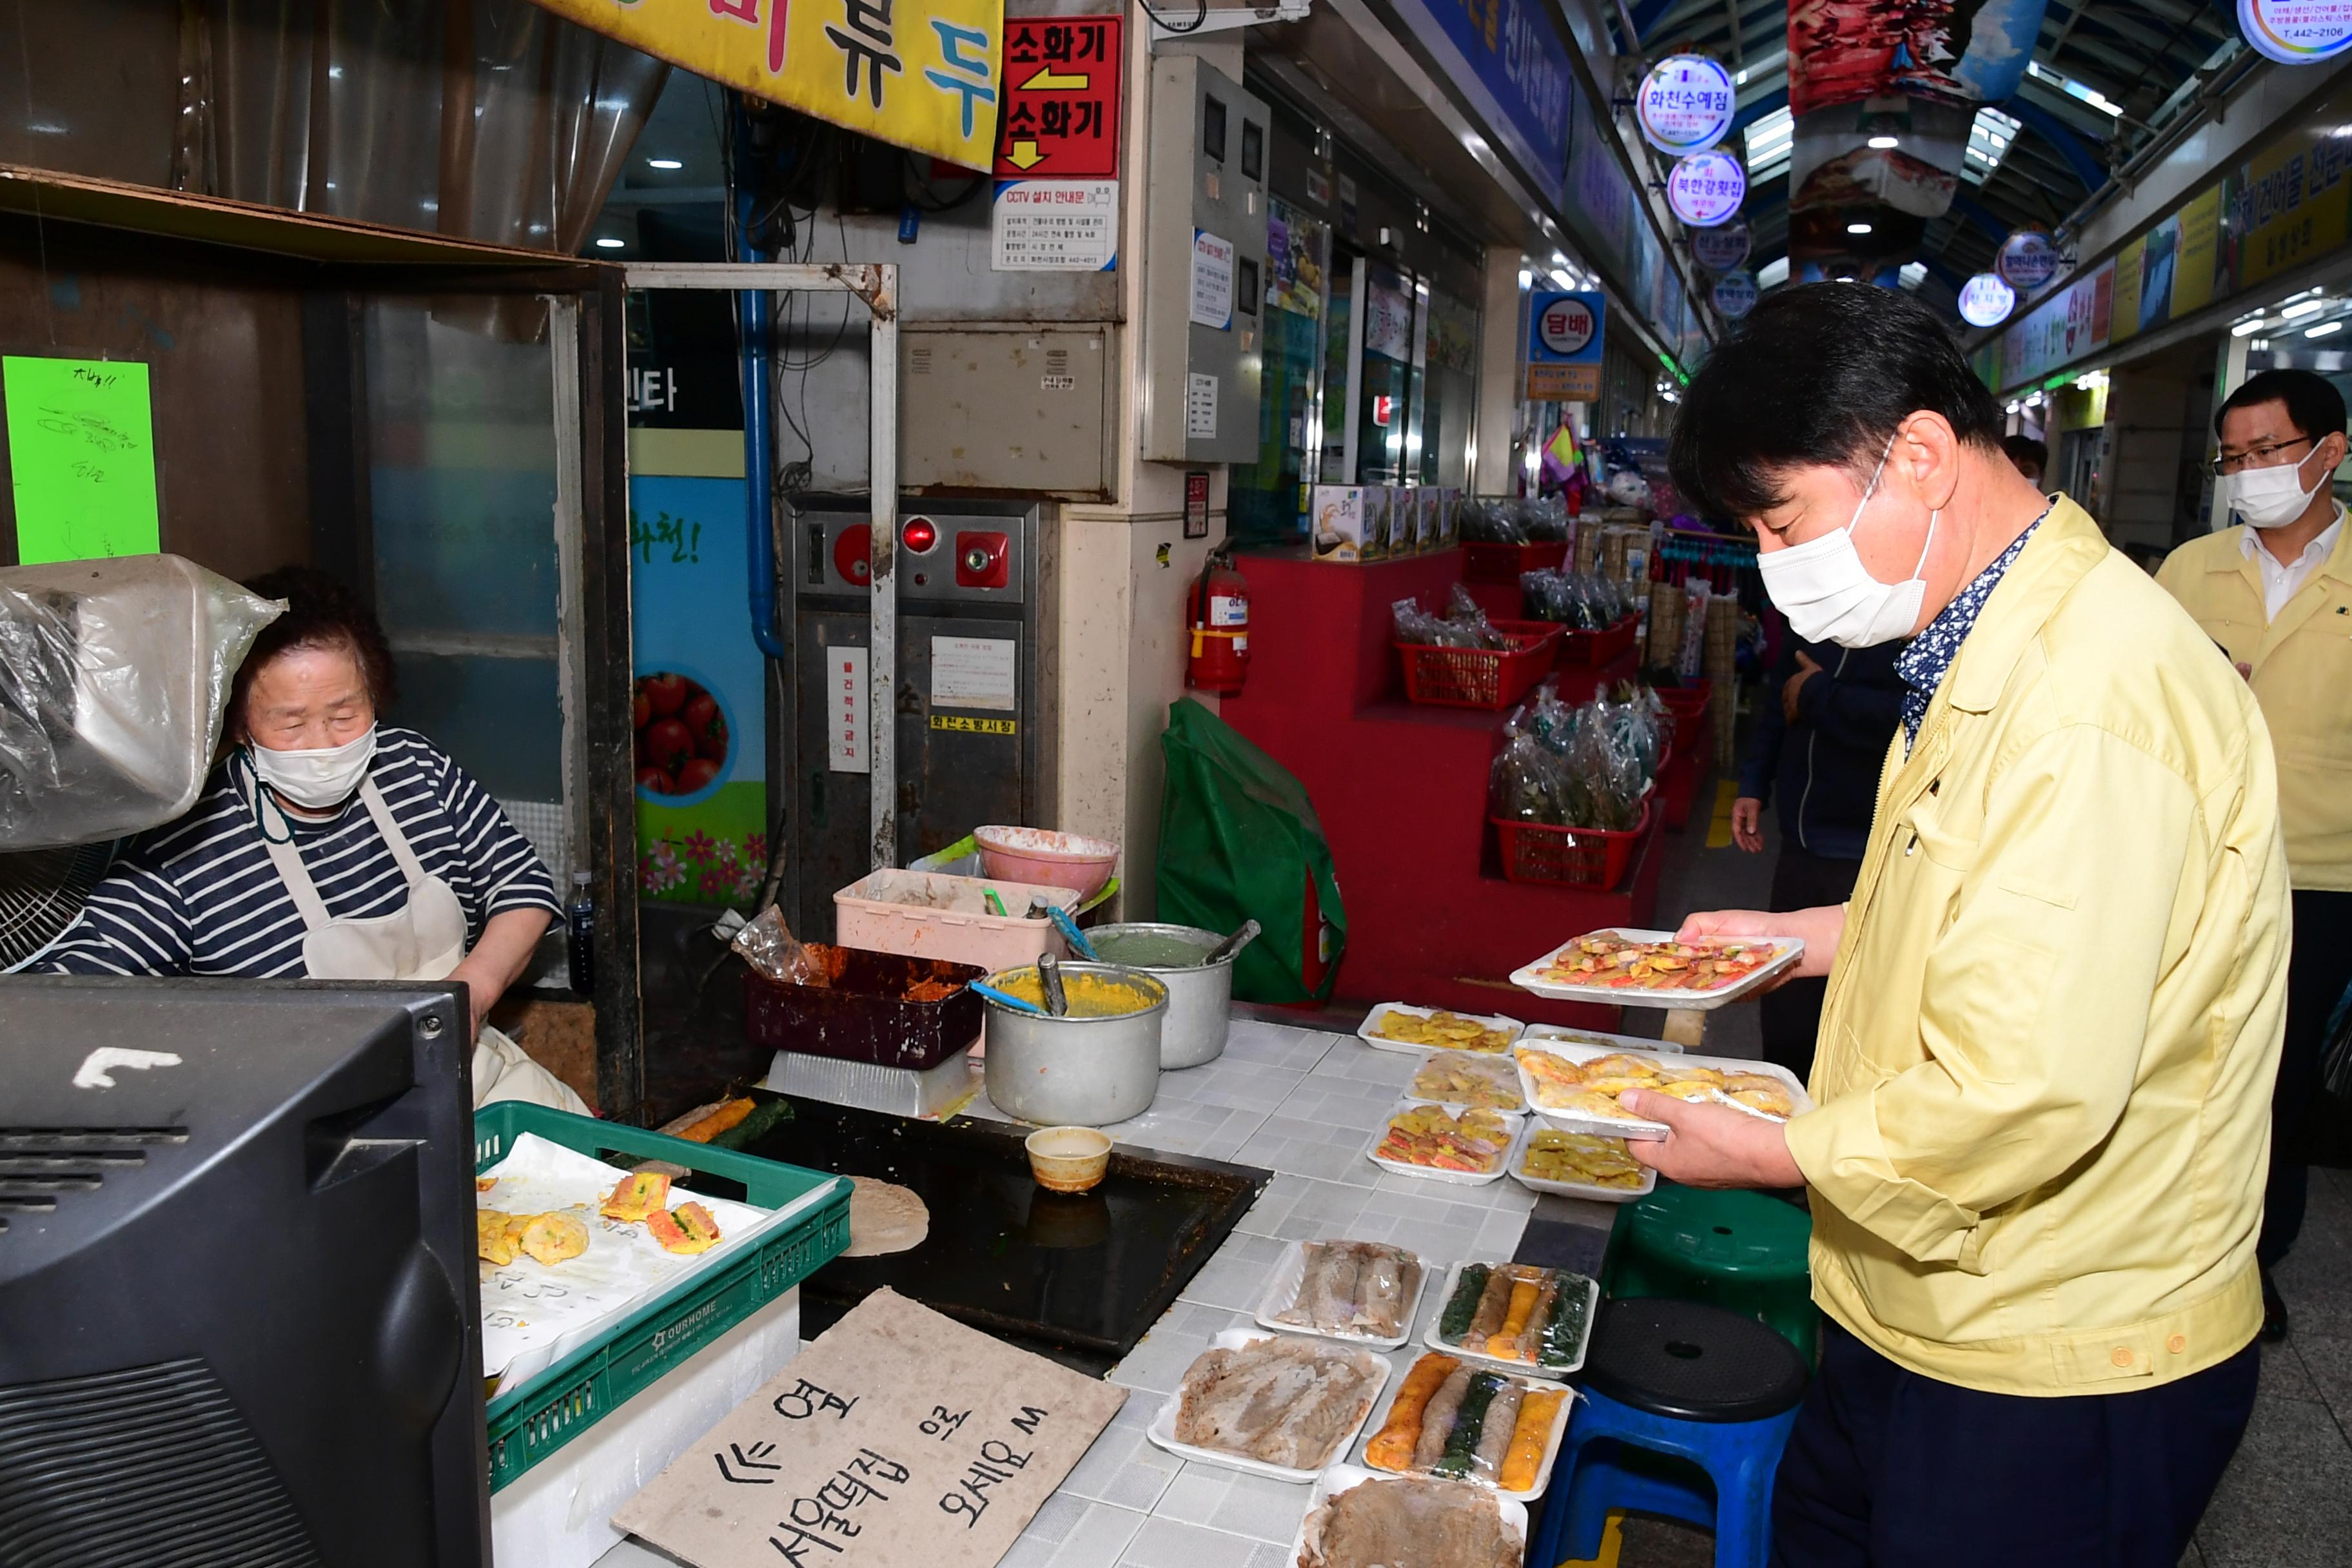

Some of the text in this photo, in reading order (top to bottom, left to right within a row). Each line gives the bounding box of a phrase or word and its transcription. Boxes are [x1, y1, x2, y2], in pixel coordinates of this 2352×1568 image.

[1010, 25, 1105, 63] 소화기
[1649, 90, 1727, 111] 화천수예점
[1008, 101, 1102, 139] 소화기
[1006, 191, 1084, 204] CCTV 설치 안내문
[1678, 178, 1742, 198] 북한강횟집
[1547, 314, 1589, 335] 담배
[843, 662, 854, 758] 물건적치금지
[933, 717, 1011, 732] 화천소방서장
[669, 1301, 717, 1339] OURHOME
[939, 1440, 1034, 1529] 오세요
[770, 1448, 910, 1568] 서울떡집
